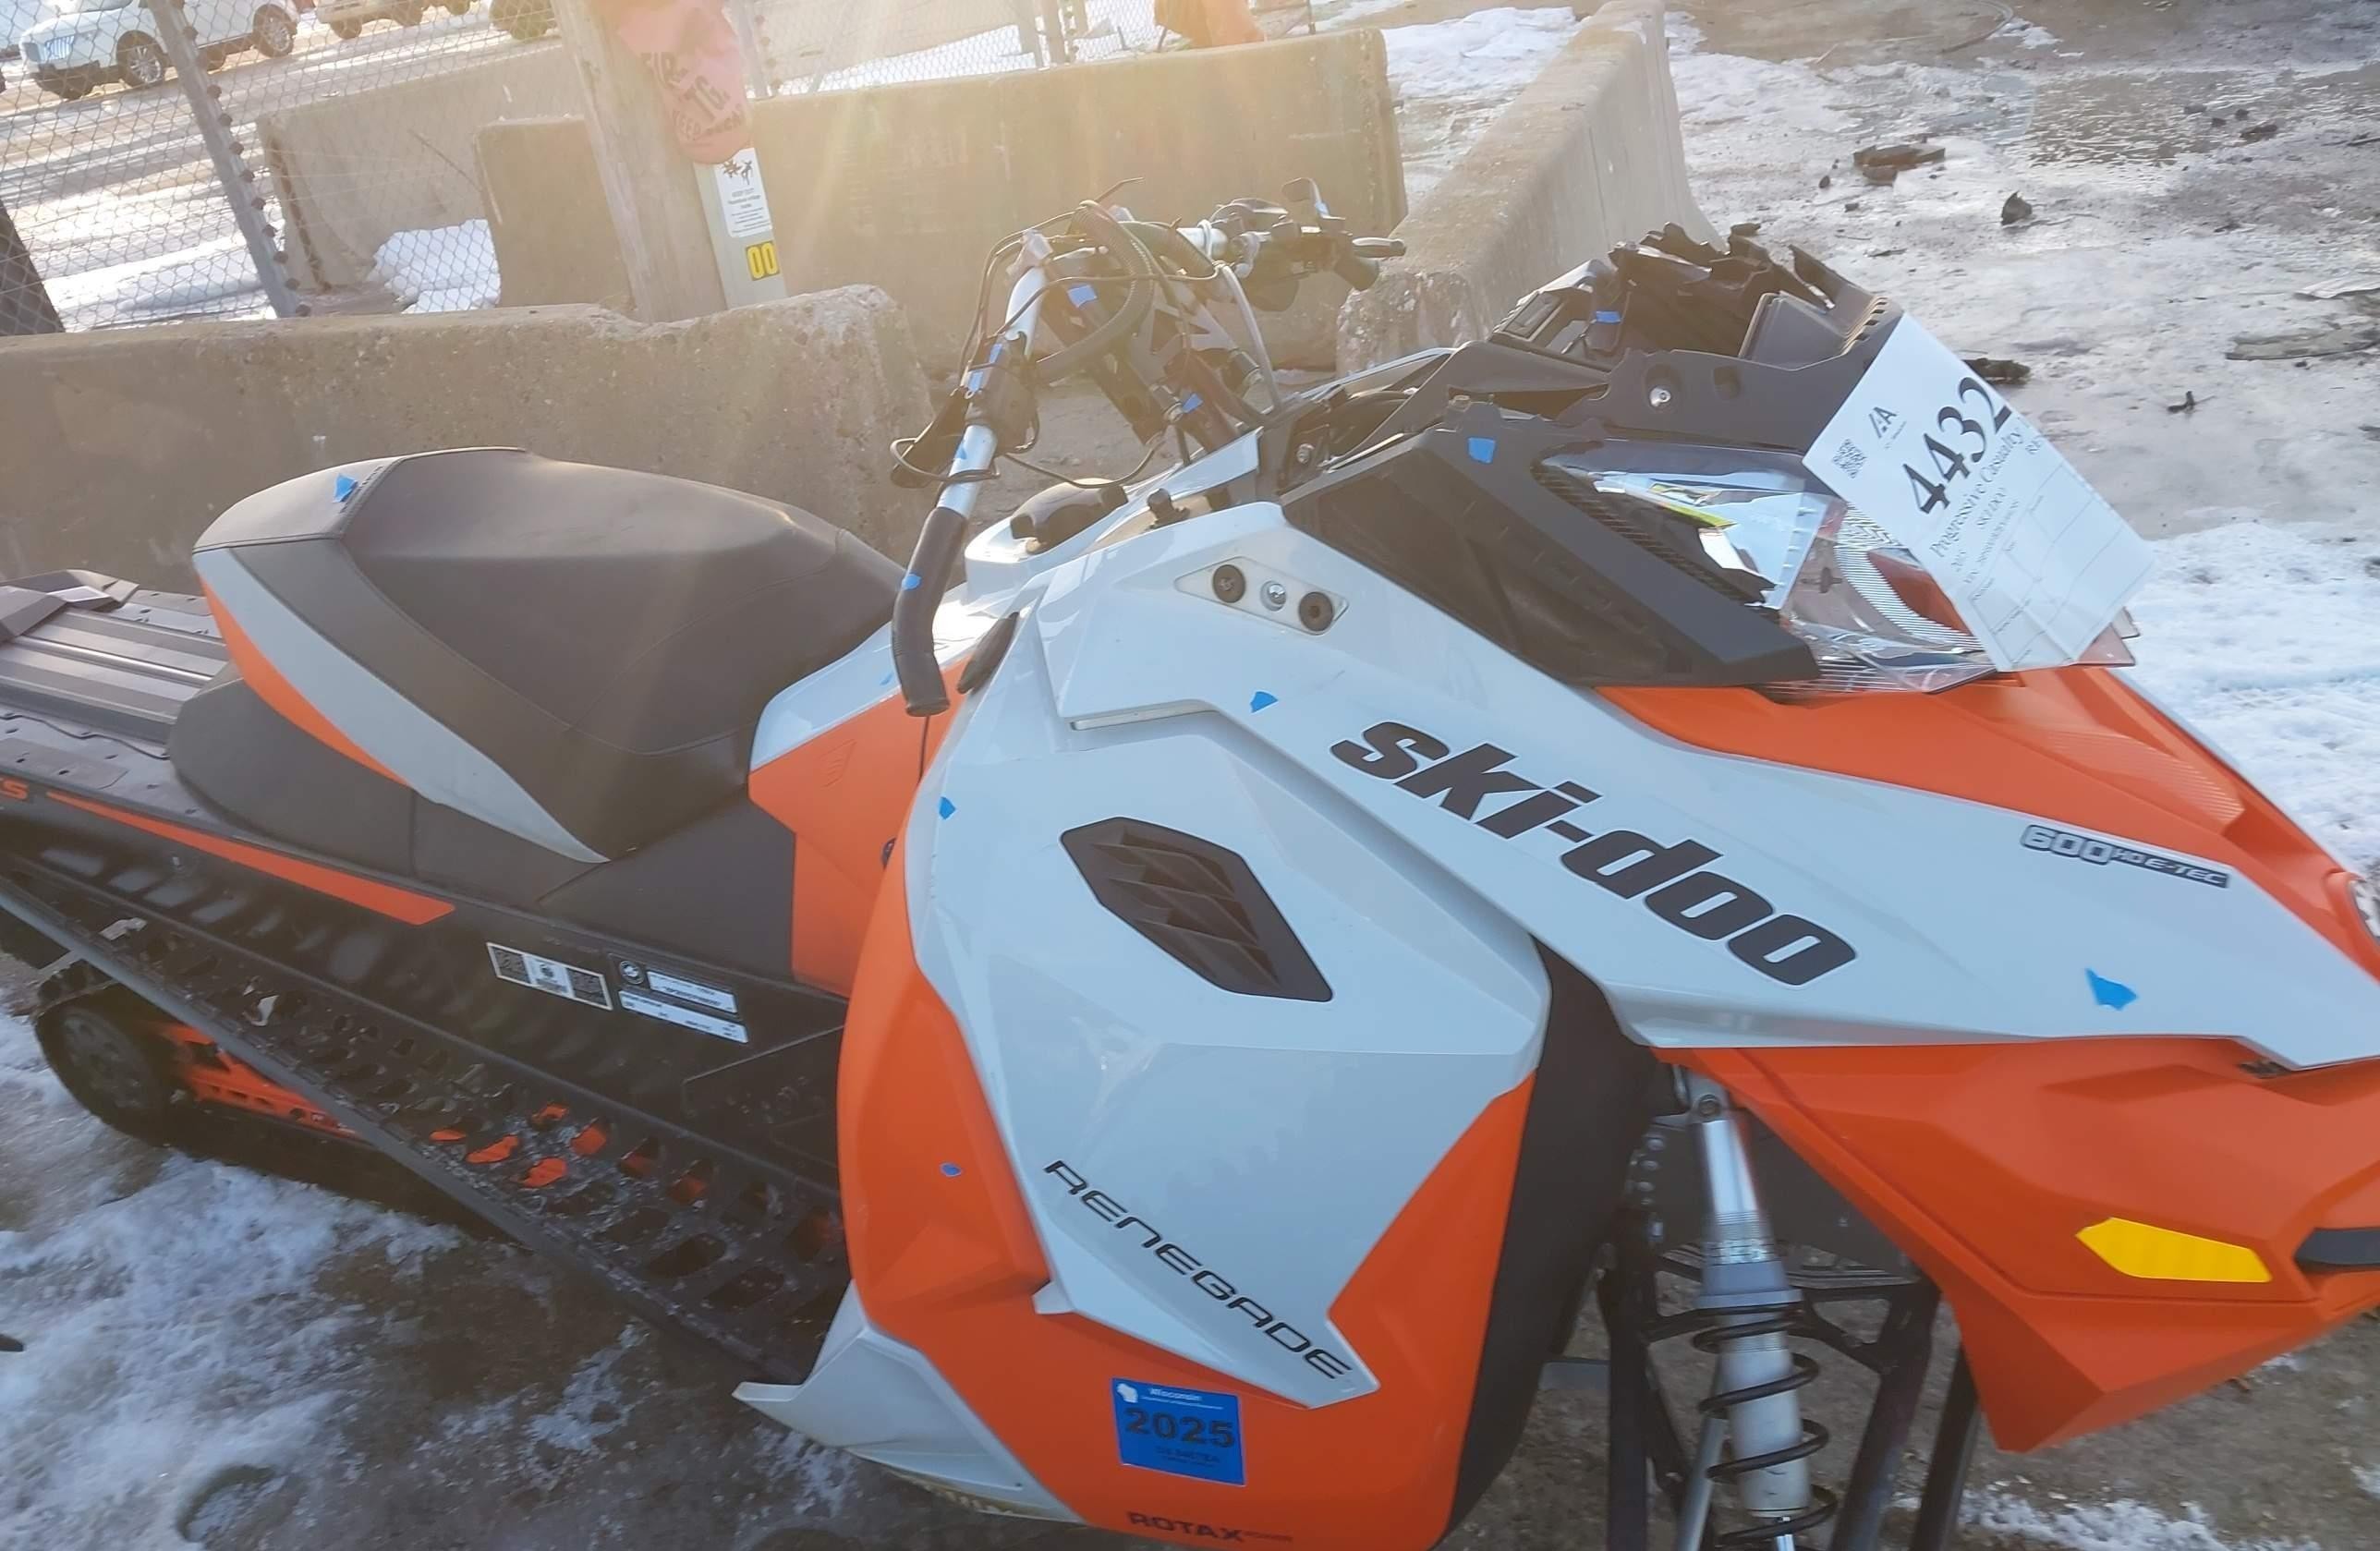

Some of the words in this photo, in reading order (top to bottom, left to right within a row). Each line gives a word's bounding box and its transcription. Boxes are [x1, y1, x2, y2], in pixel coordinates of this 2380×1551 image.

[1903, 377, 2012, 514] 4432
[1929, 483, 1987, 558] Progressive
[1980, 427, 2024, 483] Casualty
[1330, 721, 1856, 986] ski-doo
[2020, 825, 2114, 866] 600
[2143, 856, 2228, 887] E-TEC
[1044, 1160, 1353, 1379] RENEGADE
[1124, 1406, 1235, 1448] 2025
[1126, 1510, 1245, 1543] ROTAX
